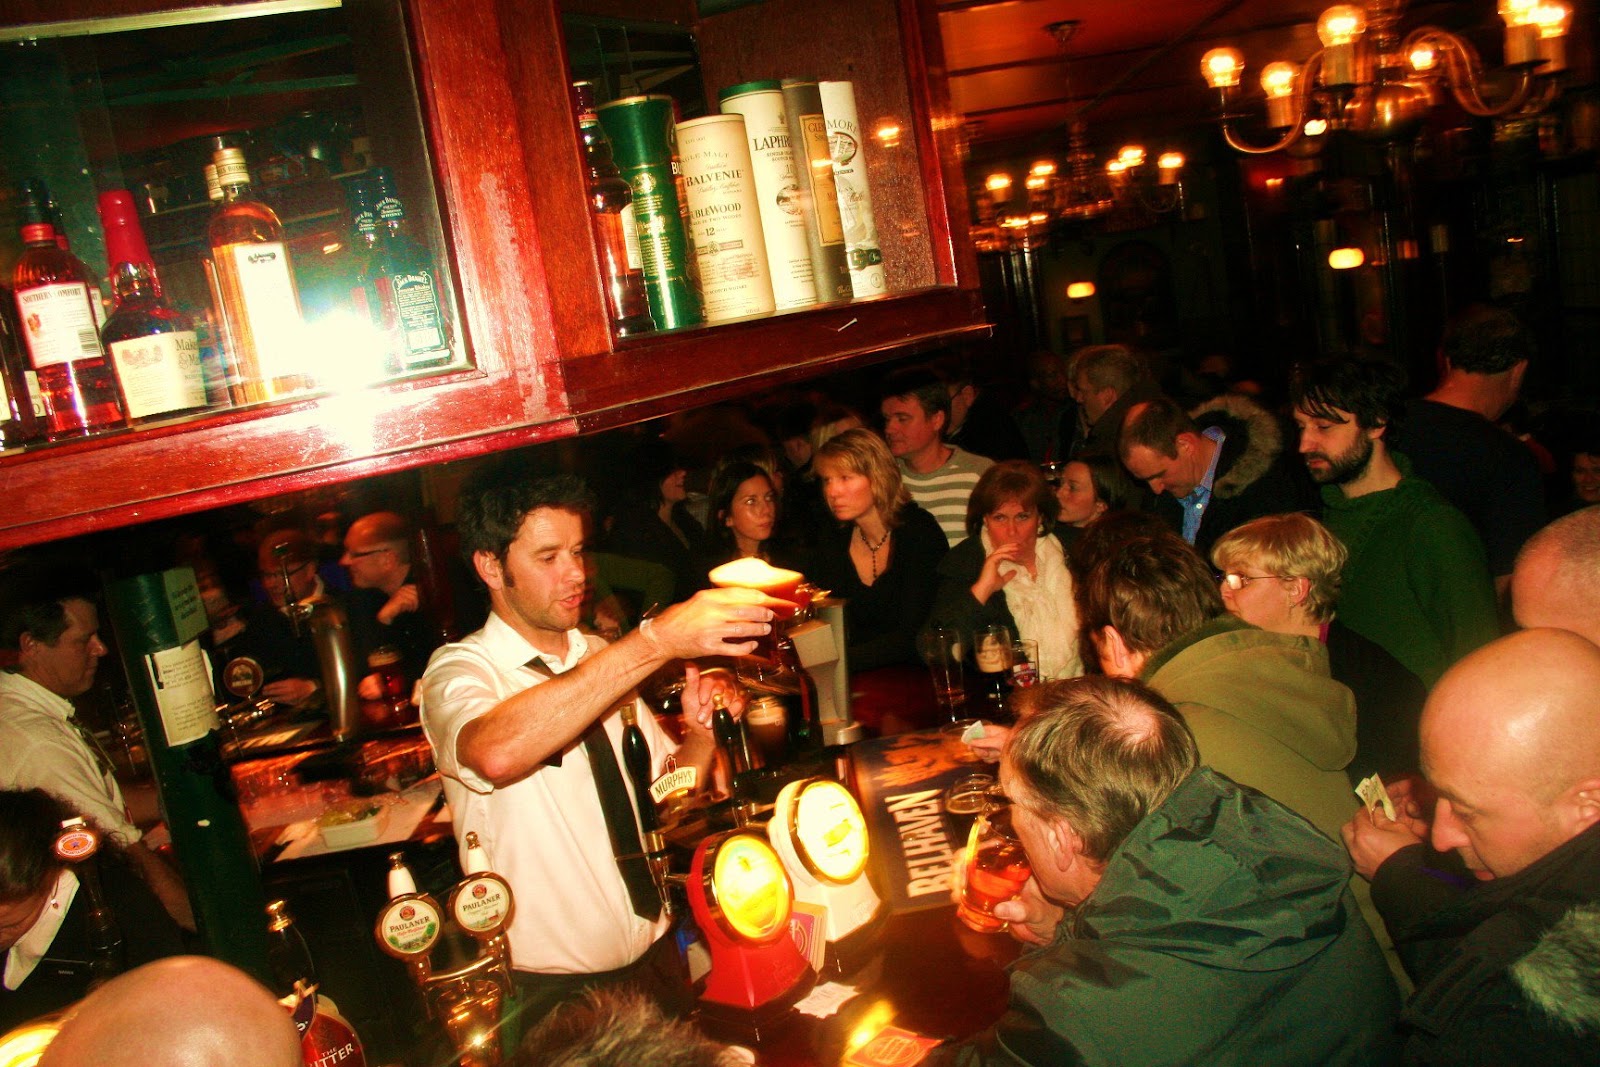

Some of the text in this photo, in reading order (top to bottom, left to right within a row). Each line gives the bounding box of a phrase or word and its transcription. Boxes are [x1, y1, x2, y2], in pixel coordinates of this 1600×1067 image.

[686, 169, 742, 187] BALVENIE
[705, 226, 716, 237] 12
[56, 287, 83, 299] OMFORT
[884, 788, 954, 898] BELHAVEN
[463, 893, 501, 912] PAULANER
[389, 915, 431, 933] PAULANER
[310, 1042, 354, 1067] ITTER
[321, 1046, 338, 1058] THE
